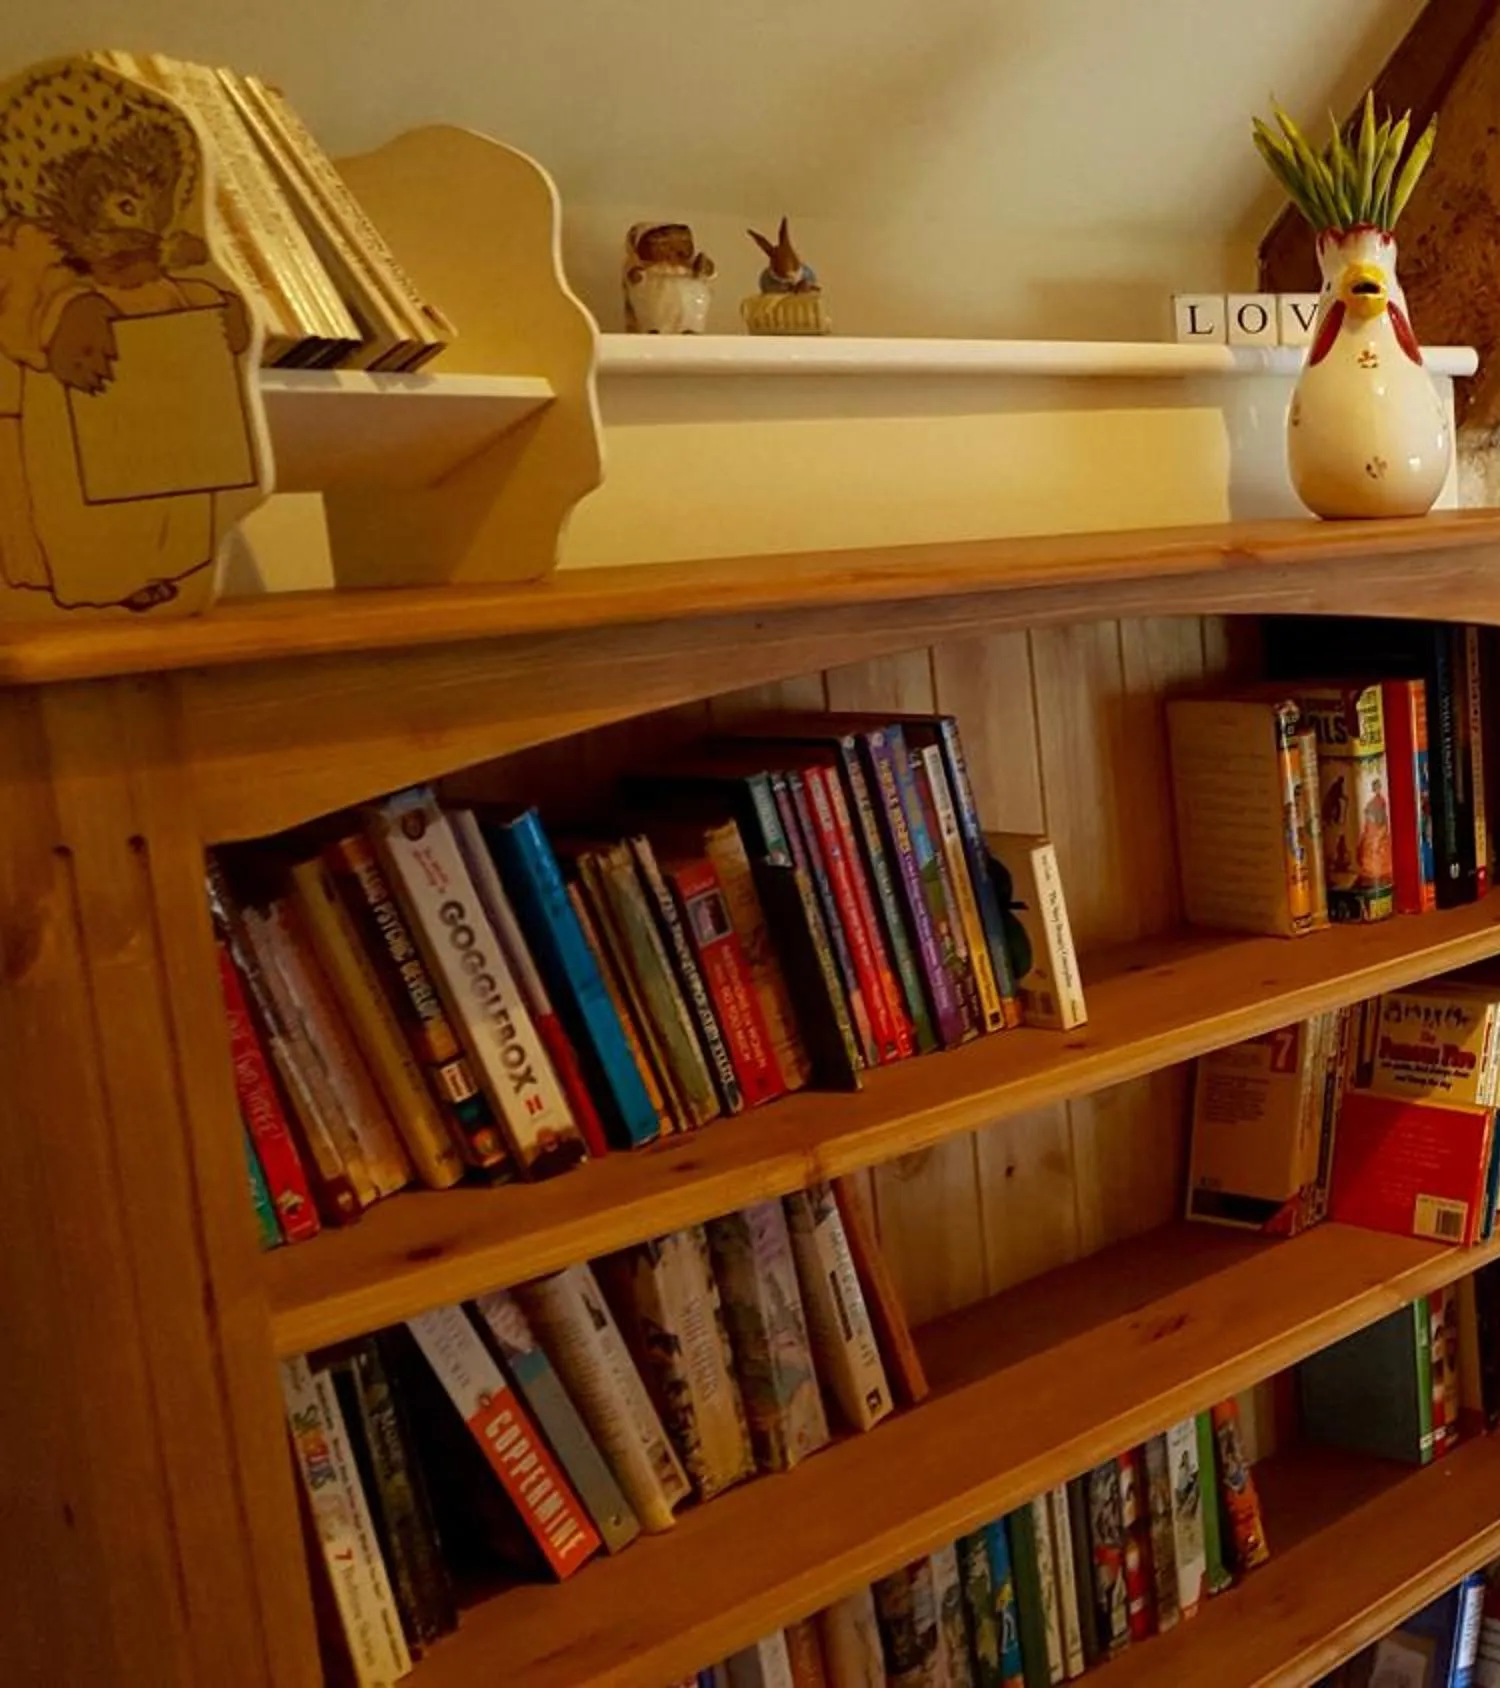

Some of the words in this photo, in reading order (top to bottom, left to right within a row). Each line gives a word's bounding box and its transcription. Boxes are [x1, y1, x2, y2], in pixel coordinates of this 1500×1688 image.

[438, 900, 541, 1096] GOGGLEBOX
[1276, 1031, 1294, 1069] 7
[484, 1408, 588, 1560] COPPERMINE
